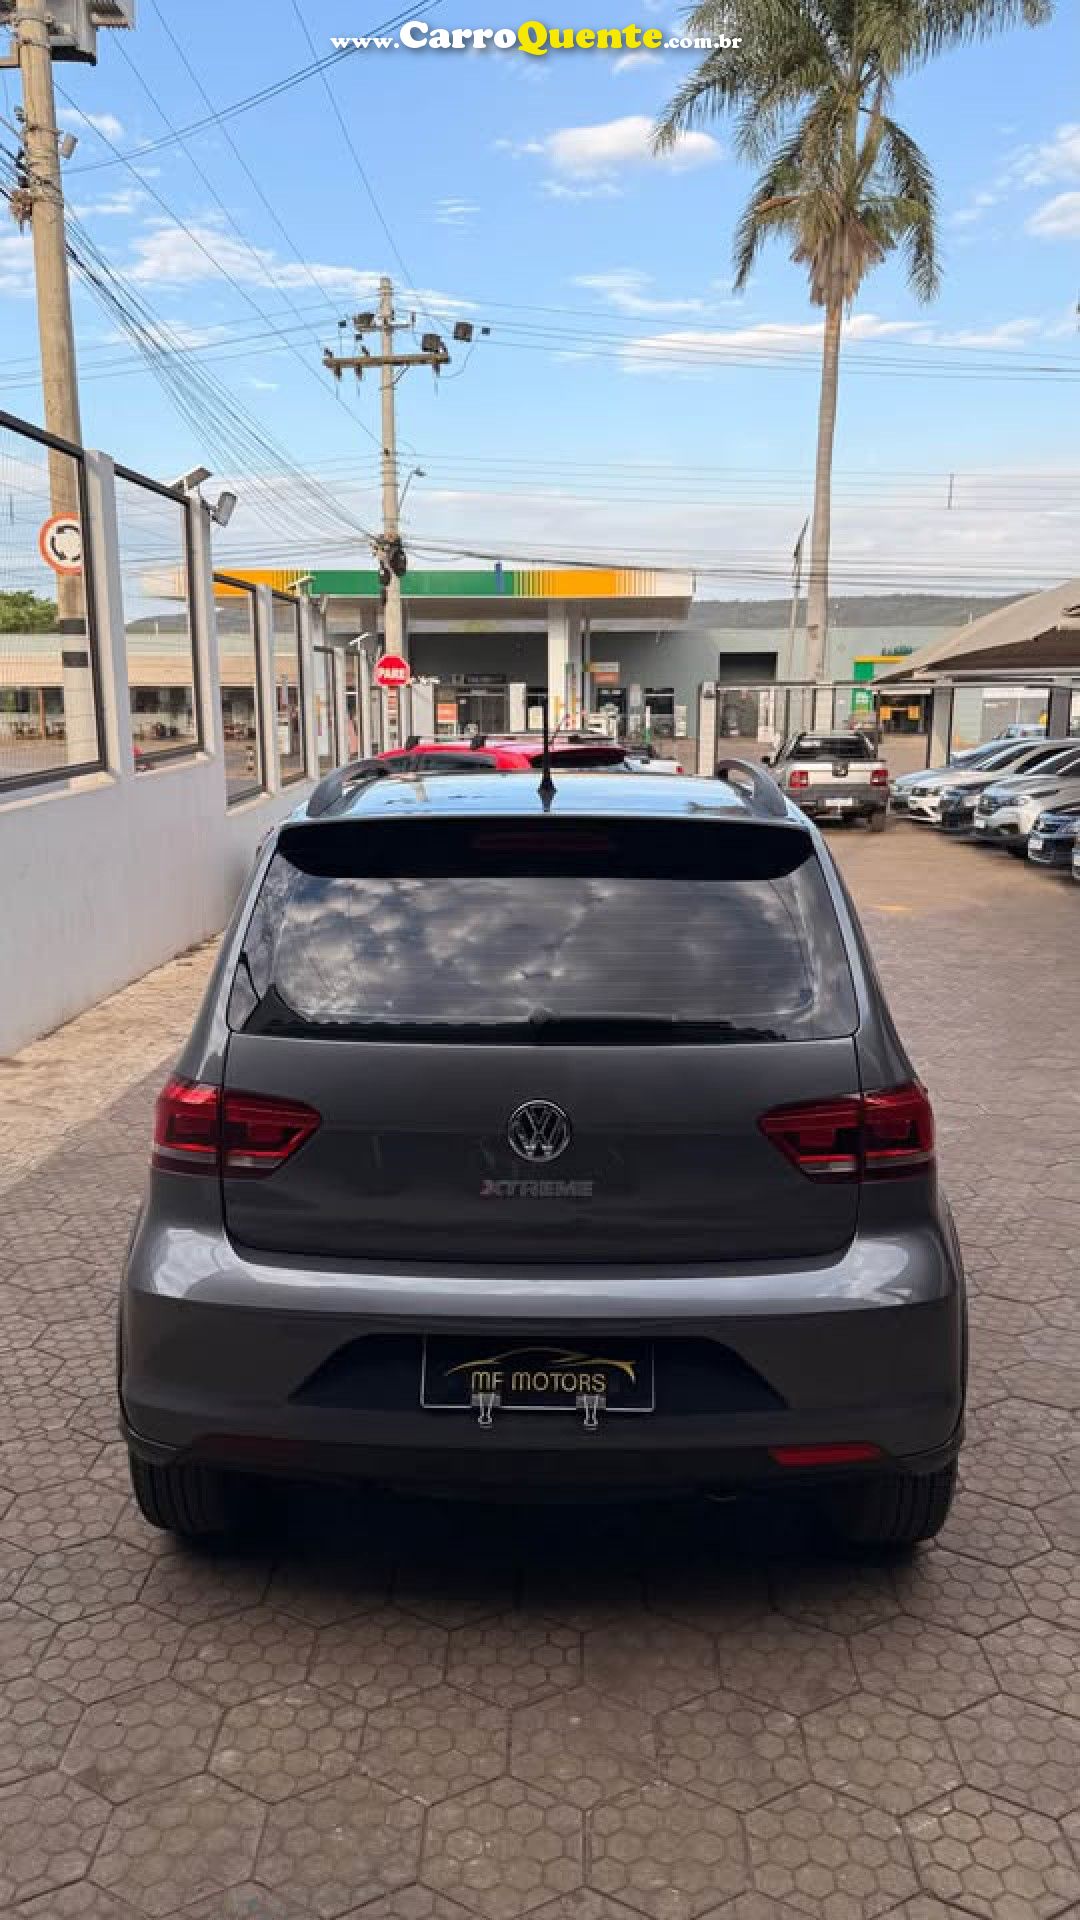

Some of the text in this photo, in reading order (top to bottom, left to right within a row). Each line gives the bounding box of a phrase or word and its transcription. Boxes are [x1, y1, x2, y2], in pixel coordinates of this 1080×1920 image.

[377, 667, 406, 679] PARE
[479, 1179, 594, 1197] XTREME
[471, 1371, 607, 1392] MF MOTORS
